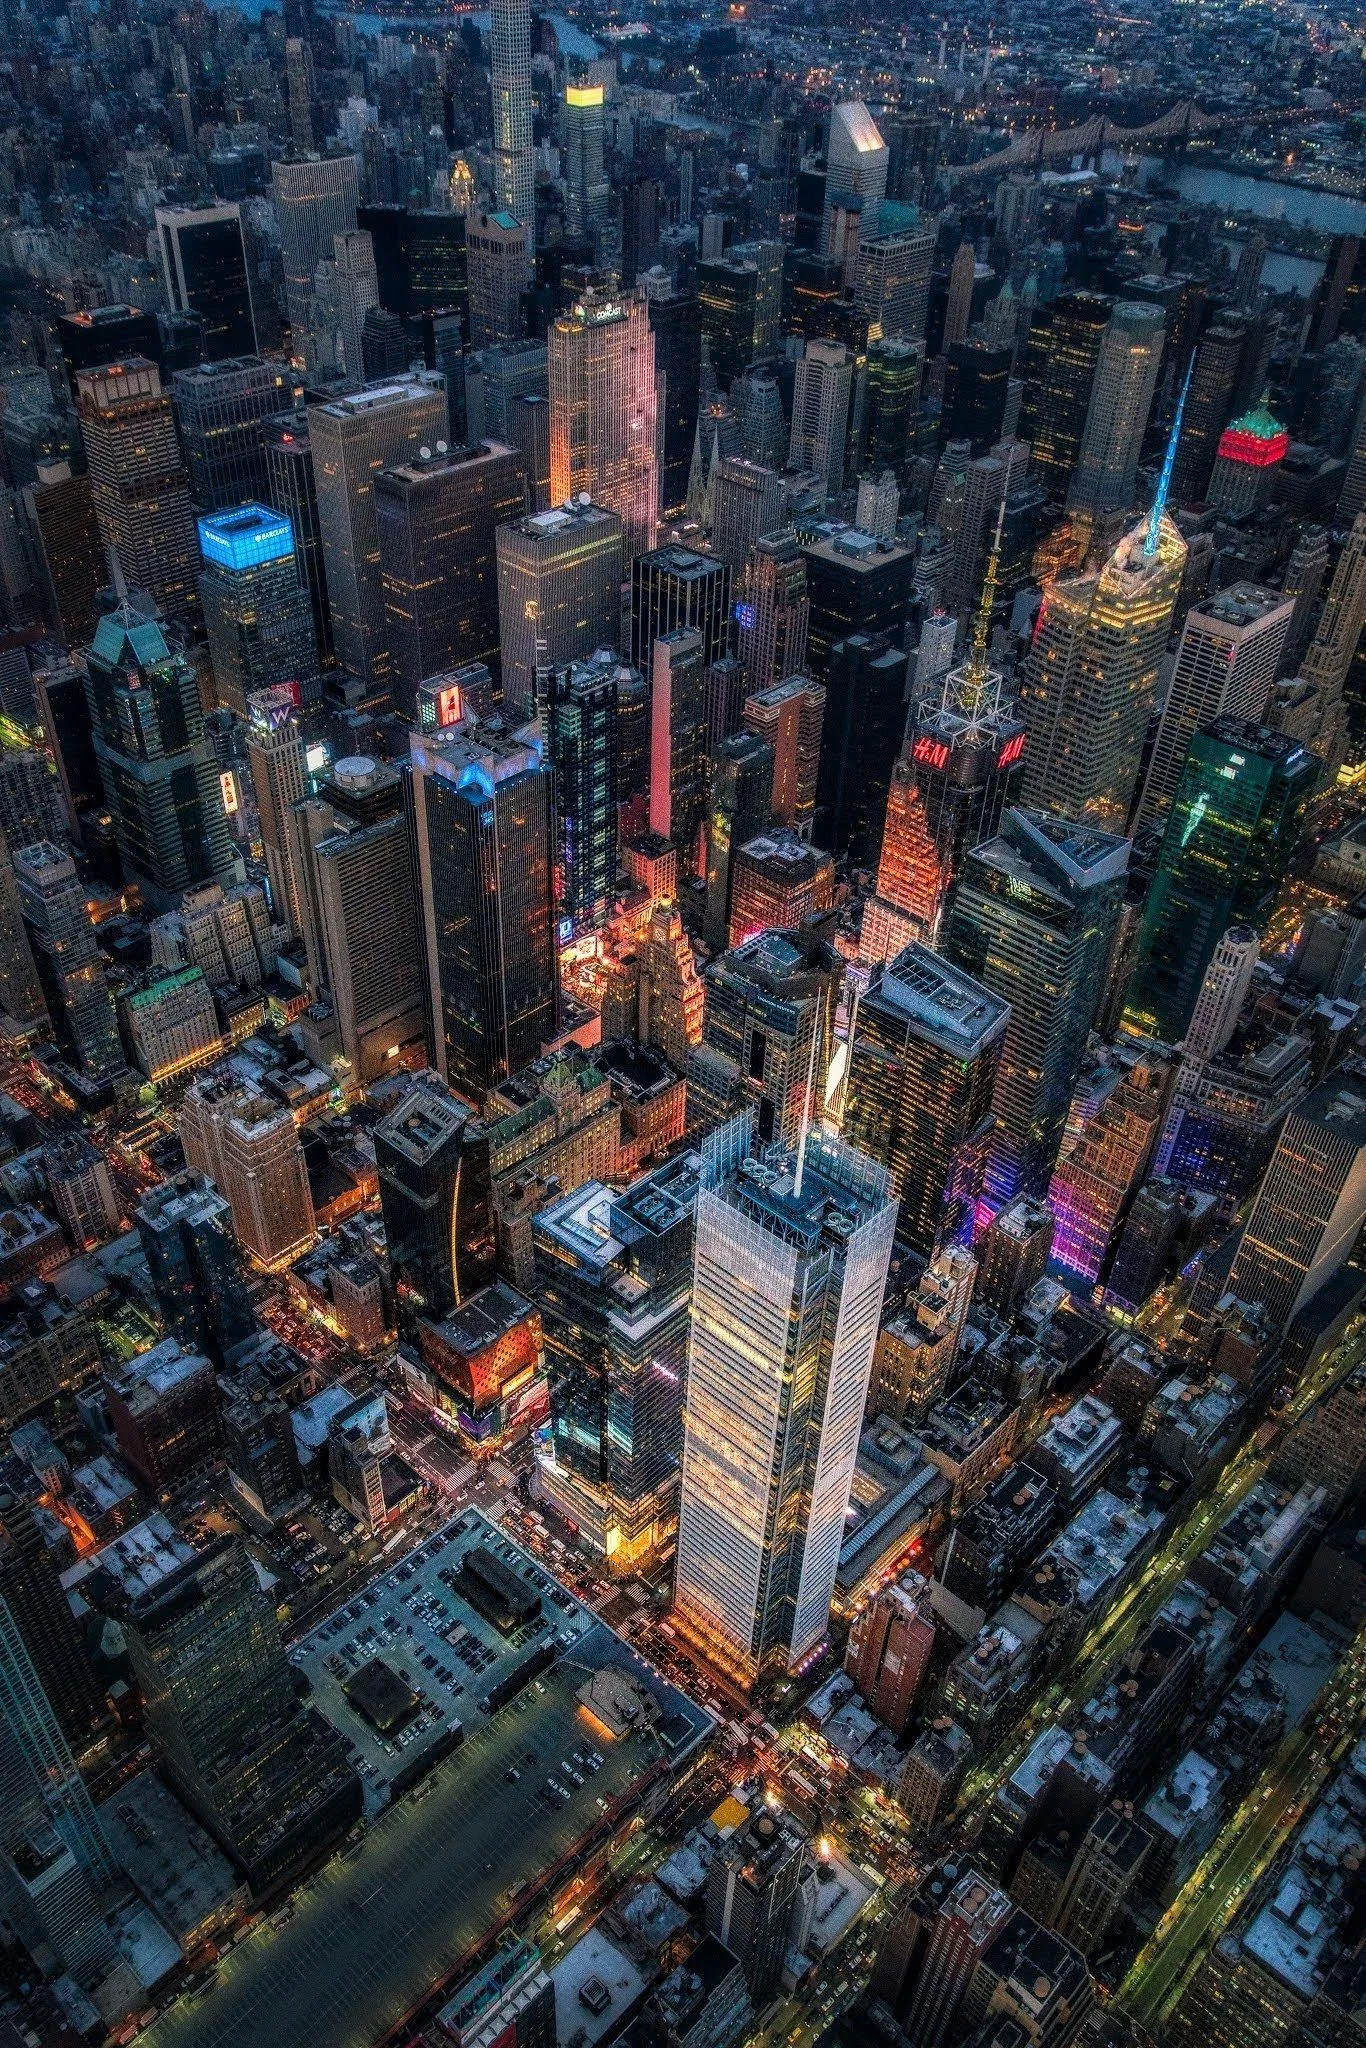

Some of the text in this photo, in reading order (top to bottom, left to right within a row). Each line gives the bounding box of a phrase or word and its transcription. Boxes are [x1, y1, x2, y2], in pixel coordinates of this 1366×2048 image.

[261, 526, 289, 541] BARCLAYS
[271, 706, 290, 724] W
[913, 737, 949, 769] H&M
